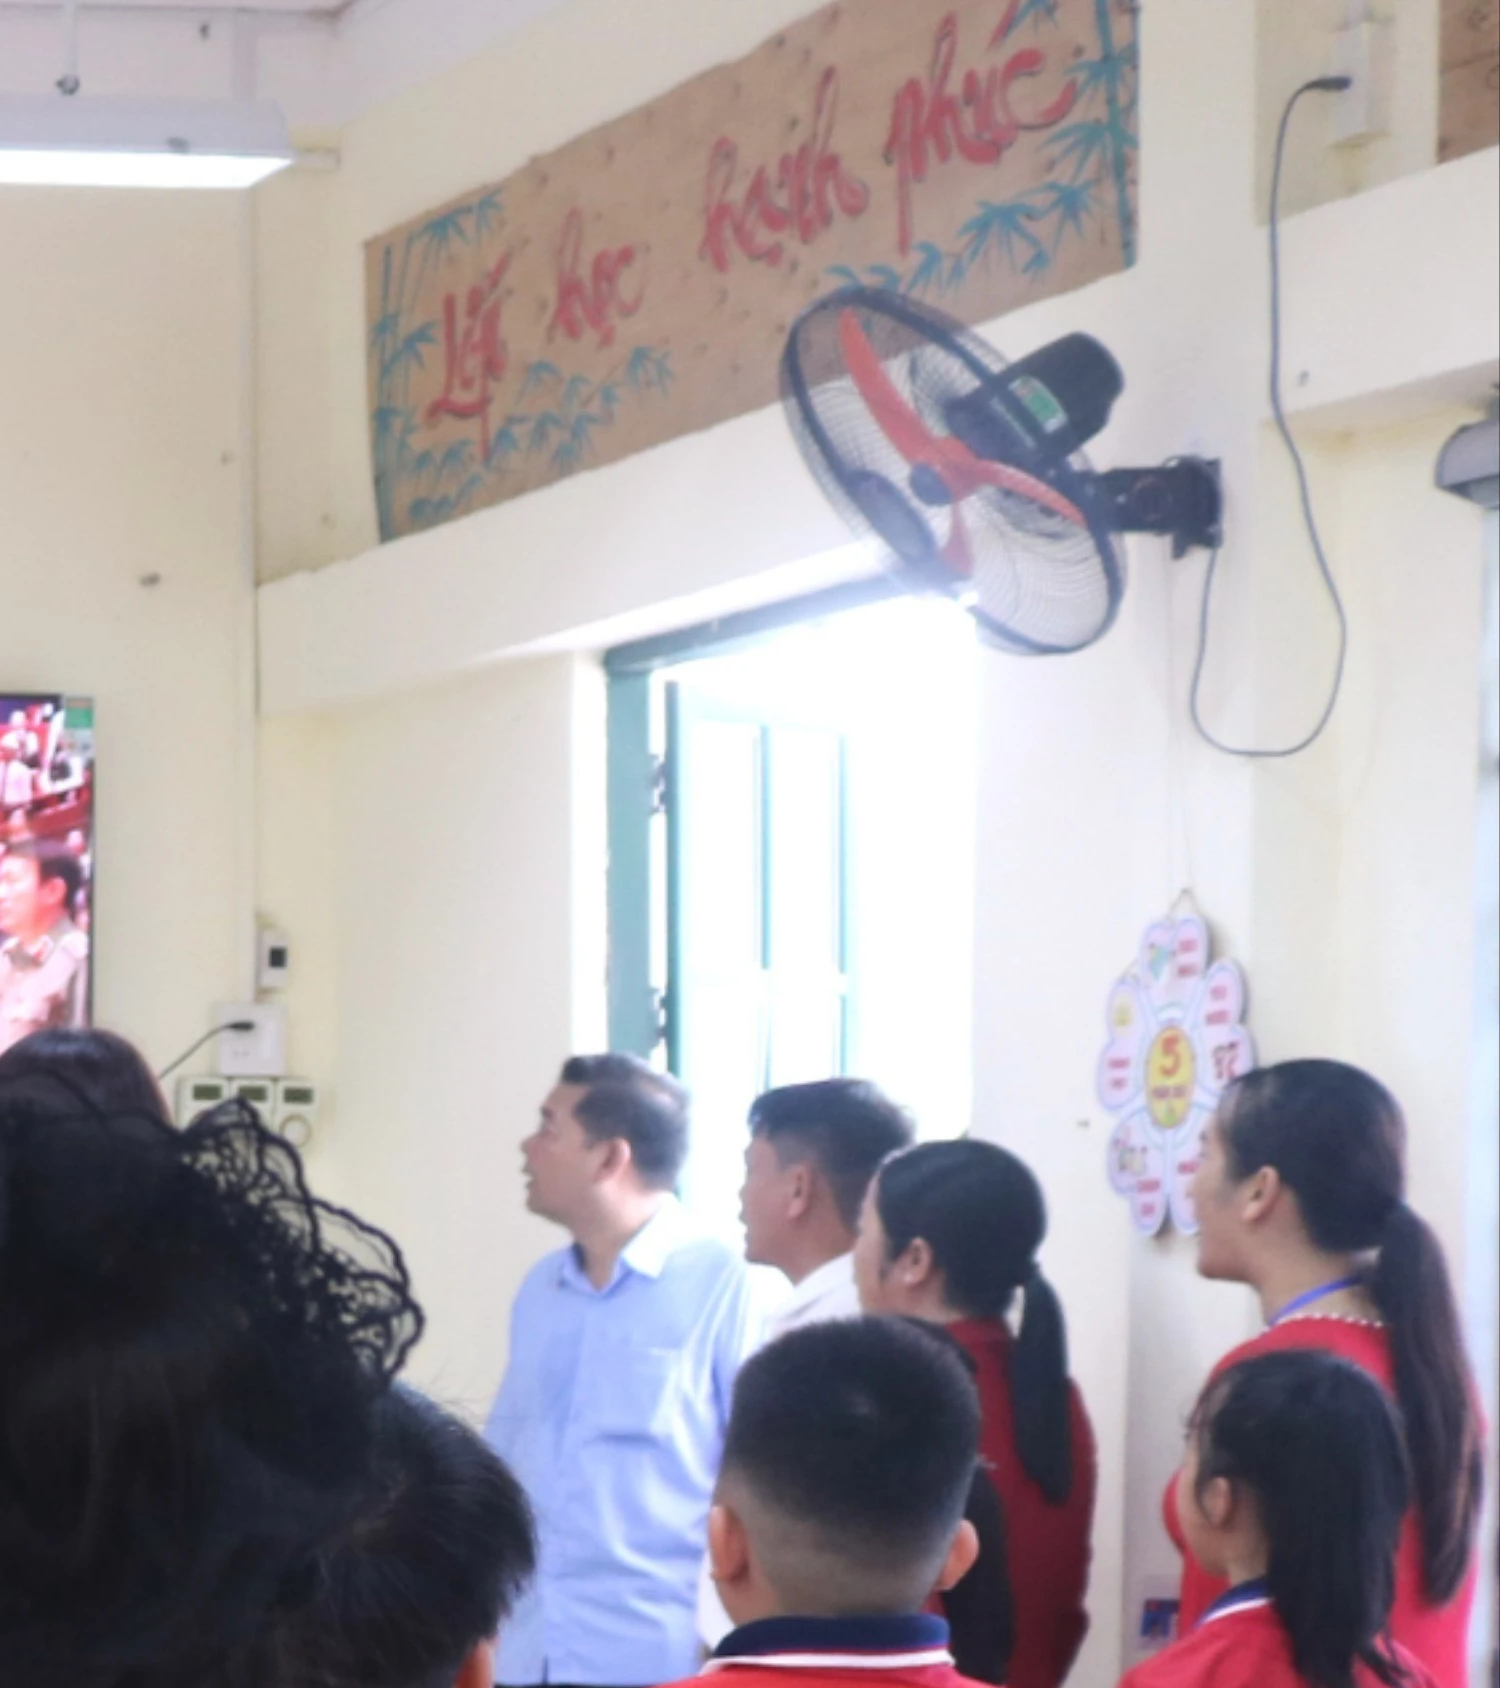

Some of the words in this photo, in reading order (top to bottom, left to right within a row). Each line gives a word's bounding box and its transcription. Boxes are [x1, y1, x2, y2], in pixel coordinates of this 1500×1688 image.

[547, 206, 647, 348] học
[700, 64, 870, 275] hạnh
[882, 0, 1080, 260] phúc
[1160, 1036, 1181, 1078] 5
